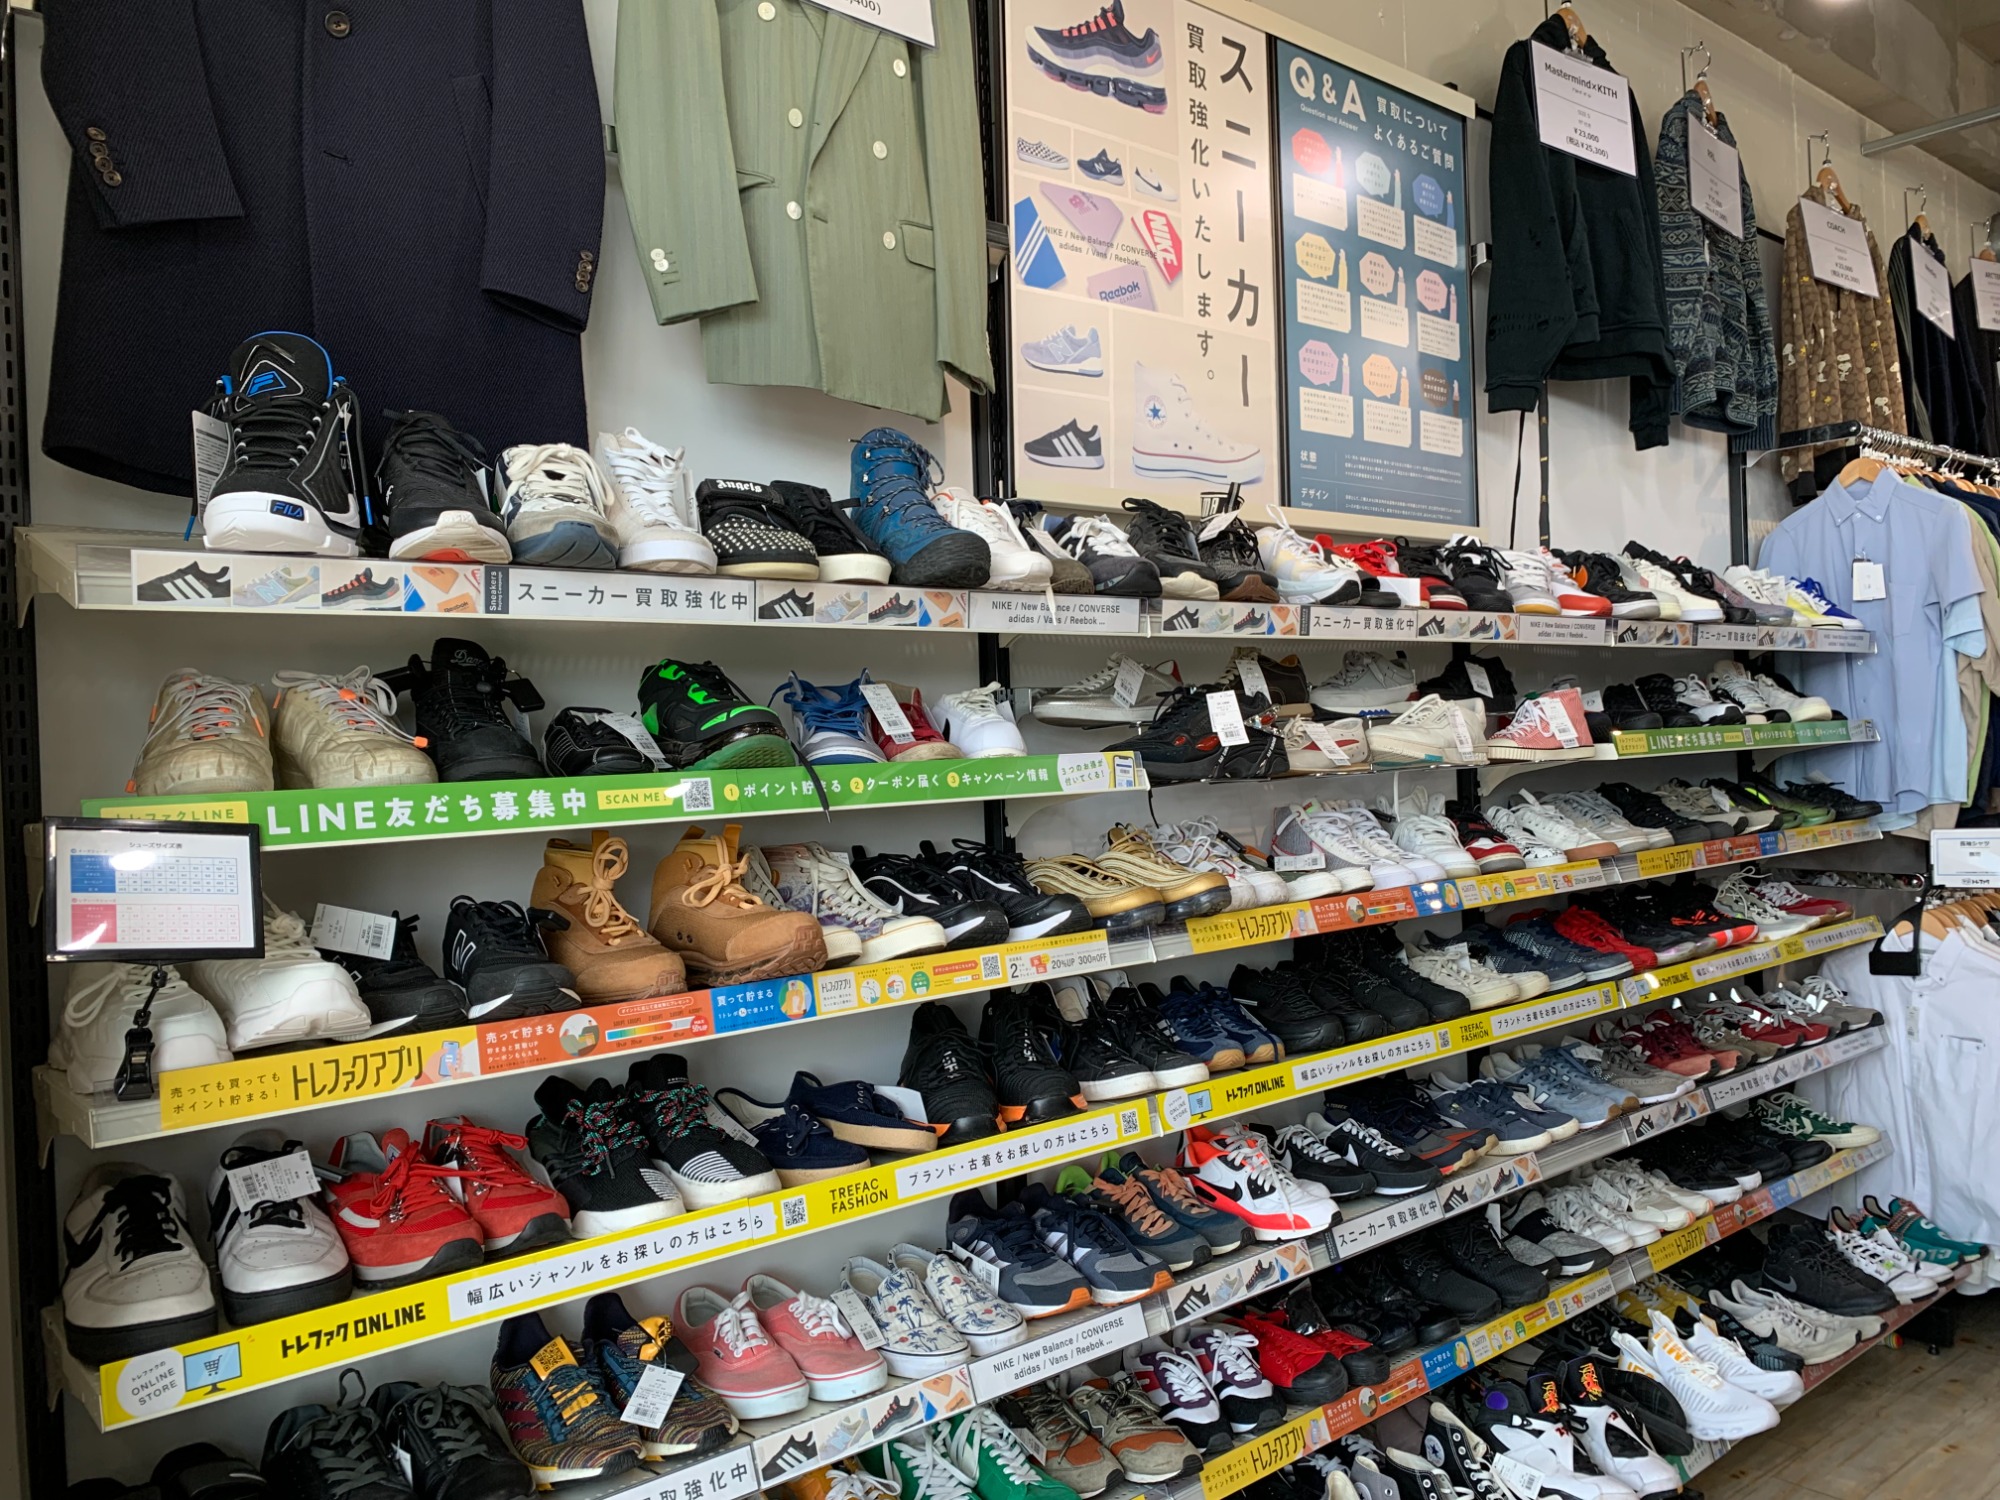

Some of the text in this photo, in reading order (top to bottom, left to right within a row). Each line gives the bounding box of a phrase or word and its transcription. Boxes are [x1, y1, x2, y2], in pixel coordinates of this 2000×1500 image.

[1300, 103, 1359, 131] Question and Answer
[1377, 96, 1448, 141] 買取について
[1374, 125, 1455, 172] よくあるご質問
[1186, 22, 1214, 381] 買取強化いたします。
[1219, 35, 1259, 408] スニーカー
[1044, 225, 1158, 260] NIKE New Balance CONVERSE
[1147, 210, 1179, 267] NIKE
[1059, 241, 1139, 267] adidas Vans Reebok
[1099, 281, 1141, 303] Reebok
[1300, 450, 1318, 462] 状態
[1300, 487, 1330, 501] デザイン
[271, 501, 305, 519] FILA
[489, 571, 497, 611] Sneakers
[517, 582, 748, 611] スニーカー買取強化中
[991, 601, 1120, 614] NIKE New Bance CONVERSE
[1008, 613, 1097, 626] adidas Vas Reebok
[1313, 615, 1415, 631] スニーカー買取強化中
[1699, 631, 1757, 643] スニーカー買取強化中
[866, 773, 941, 791] クーポン届く
[961, 768, 1049, 786] キャンペーン情報
[605, 792, 638, 805] SCAN
[743, 780, 842, 798] ポイント貯る
[266, 787, 587, 836] LINE友だち募集中
[129, 841, 183, 850] シューズサイズ表
[1553, 878, 1560, 889] 2
[1315, 901, 1345, 912] 売って貯まる
[1192, 921, 1235, 935] 売っても買っても
[1237, 911, 1293, 941] トレファクアプリ
[1010, 963, 1019, 978] 2
[1051, 958, 1075, 969] 20%UP
[1078, 953, 1107, 966] 300円OFF
[821, 979, 852, 993] トレファクアプリ
[716, 989, 774, 1007] 買って貯まる
[1497, 996, 1598, 1030] ブランド・古着をお探しの方はこちら
[485, 1023, 555, 1045] 売って貯まる
[1460, 1021, 1484, 1034] TREFAC
[1461, 1029, 1489, 1043] FASHION
[487, 1041, 539, 1054] 貯まると買取UP
[488, 1050, 539, 1063] クーポンもらえる
[1301, 1038, 1432, 1082] 幅広いジャンルをお探しの方はこちら
[292, 1046, 423, 1101] トレファクアプリ
[170, 1071, 281, 1100] 売っても買っても
[1226, 1076, 1285, 1102] トレファク ONLINE
[1169, 1099, 1187, 1115] ONLINE
[1172, 1109, 1188, 1122] STORE
[909, 1122, 1110, 1187] ブランド・古着をお探しの方はこちら
[829, 1178, 879, 1201] TREFAC
[831, 1188, 889, 1214] FASHION
[1338, 1199, 1439, 1247] スニーカー買取強化中
[466, 1214, 764, 1305] 幅広いジャンルをお探しの方はこちら
[1563, 1303, 1570, 1315] 2
[281, 1302, 426, 1358] トレファク ONLINE
[993, 1357, 1016, 1374] NIKE
[1023, 1347, 1040, 1363] New
[1042, 1335, 1075, 1358] Balance
[1081, 1316, 1125, 1341] CONVERSE
[1014, 1364, 1042, 1382] adidas
[1048, 1353, 1069, 1369] Vans
[1076, 1340, 1105, 1359] Reebok
[1424, 1351, 1451, 1368] 買って貯まる
[131, 1360, 167, 1382] トレファクの
[131, 1366, 177, 1397] ONLINE
[138, 1379, 178, 1406] STORE
[1327, 1397, 1358, 1419] 売って貯まる
[1250, 1425, 1305, 1475] トレファクアプリ
[1204, 1457, 1249, 1484] 売っても買っても
